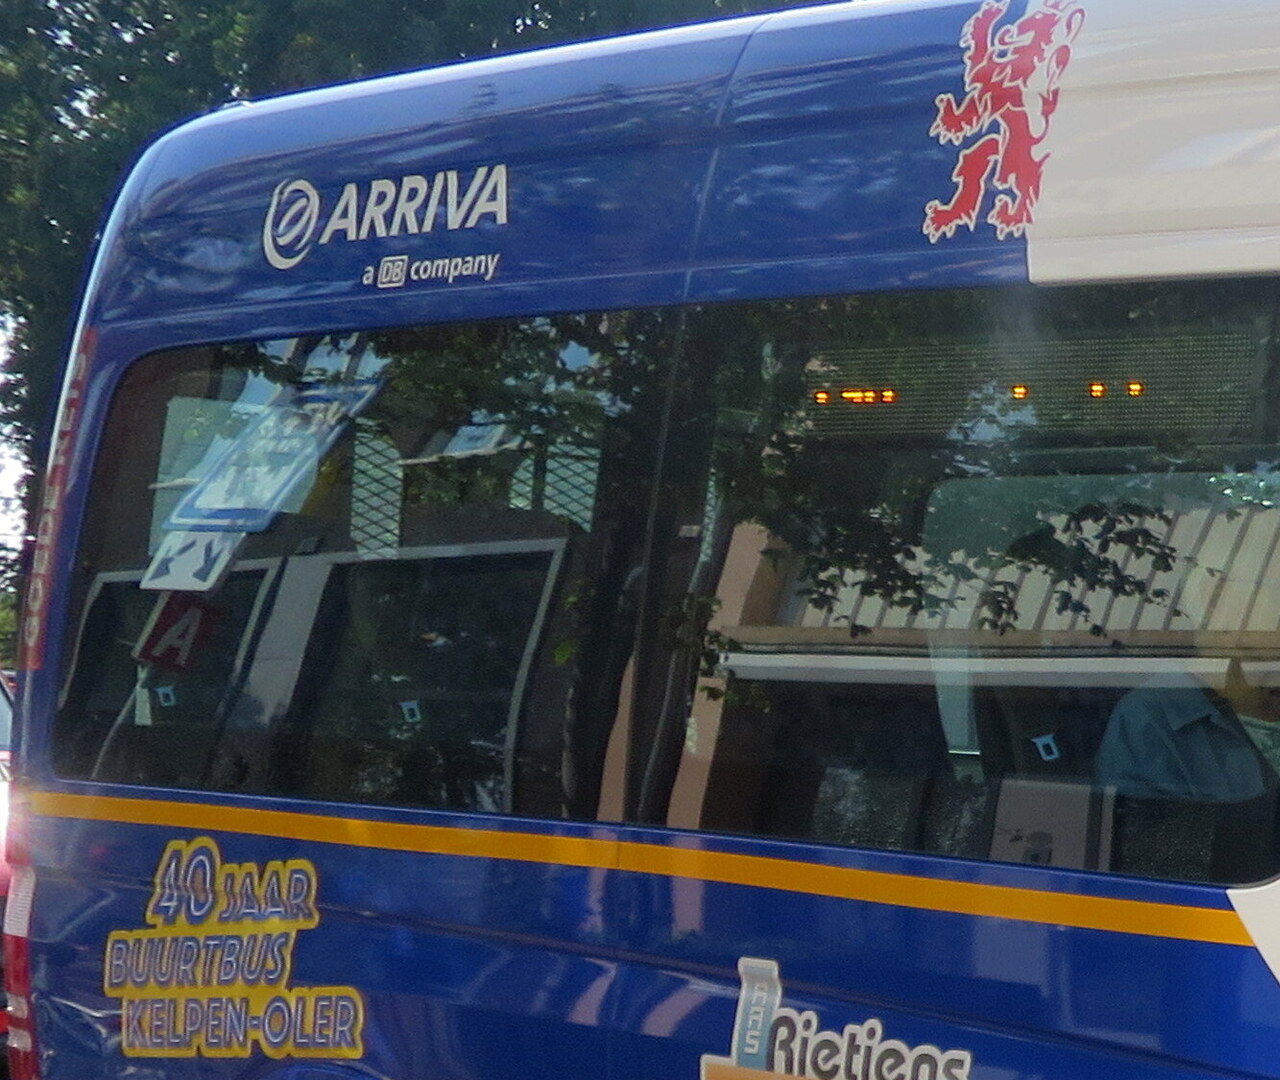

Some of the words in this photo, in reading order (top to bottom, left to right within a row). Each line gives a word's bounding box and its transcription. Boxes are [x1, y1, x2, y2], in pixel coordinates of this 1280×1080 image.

[318, 164, 508, 245] ARRIVA
[362, 266, 375, 286] a
[379, 257, 406, 286] DB
[410, 253, 501, 284] company
[155, 848, 215, 925] 40
[218, 867, 315, 922] JAAR
[107, 932, 287, 988] BUURTBUS
[125, 995, 356, 1049] KELPEN-OLER
